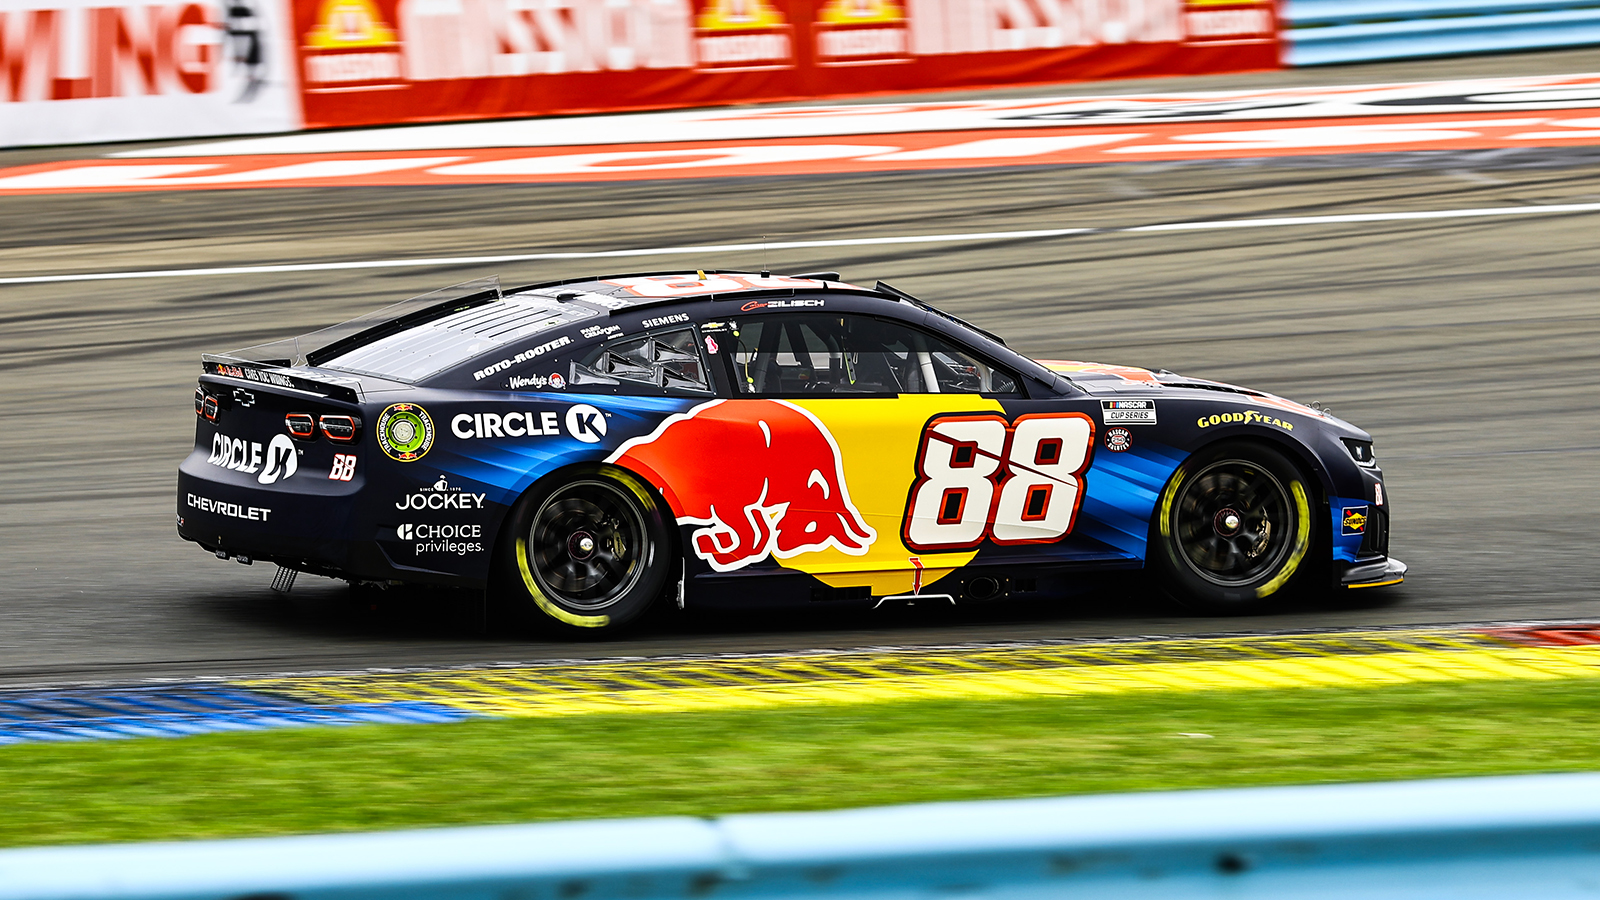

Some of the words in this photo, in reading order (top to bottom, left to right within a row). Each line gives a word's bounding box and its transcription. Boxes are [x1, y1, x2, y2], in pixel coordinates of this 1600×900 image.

[767, 299, 825, 308] ZILISCH
[641, 313, 690, 329] SIEMENS
[509, 374, 548, 390] Wendy's
[1119, 401, 1147, 409] NASCAR
[1110, 411, 1125, 419] CUP
[1125, 411, 1149, 419] SERIES
[1197, 410, 1294, 431] GOODYEAR
[451, 411, 561, 440] CIRCLE
[571, 408, 606, 442] K
[206, 431, 262, 474] CIRCLE
[264, 441, 294, 481] K
[328, 453, 357, 482] 88
[902, 411, 1096, 551] 88
[187, 492, 272, 522] CHEVROLET
[415, 524, 481, 538] CHOICE
